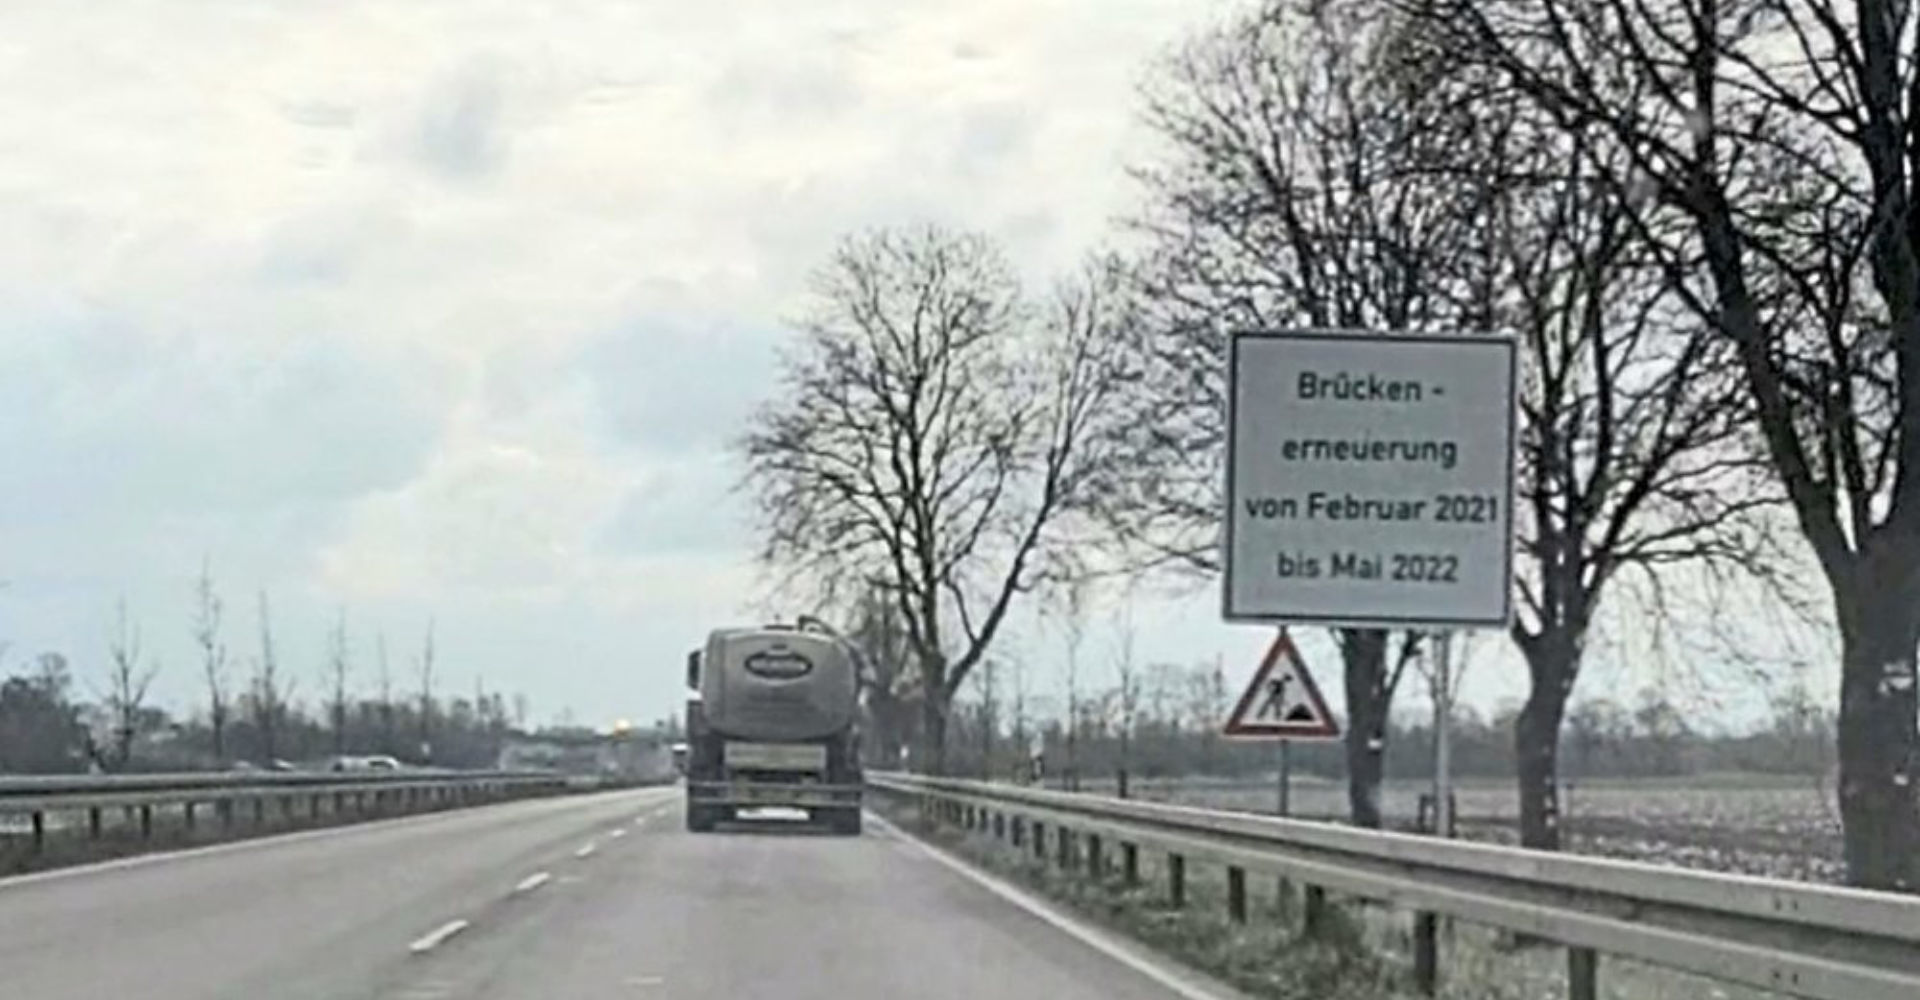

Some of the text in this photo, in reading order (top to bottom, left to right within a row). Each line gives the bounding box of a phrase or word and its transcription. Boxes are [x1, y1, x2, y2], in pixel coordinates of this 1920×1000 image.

[1297, 370, 1422, 401] Brücken
[1281, 437, 1458, 470] erneuerung
[1246, 491, 1498, 523] von Februar 2021
[1277, 552, 1459, 583] bis Mai 2022
